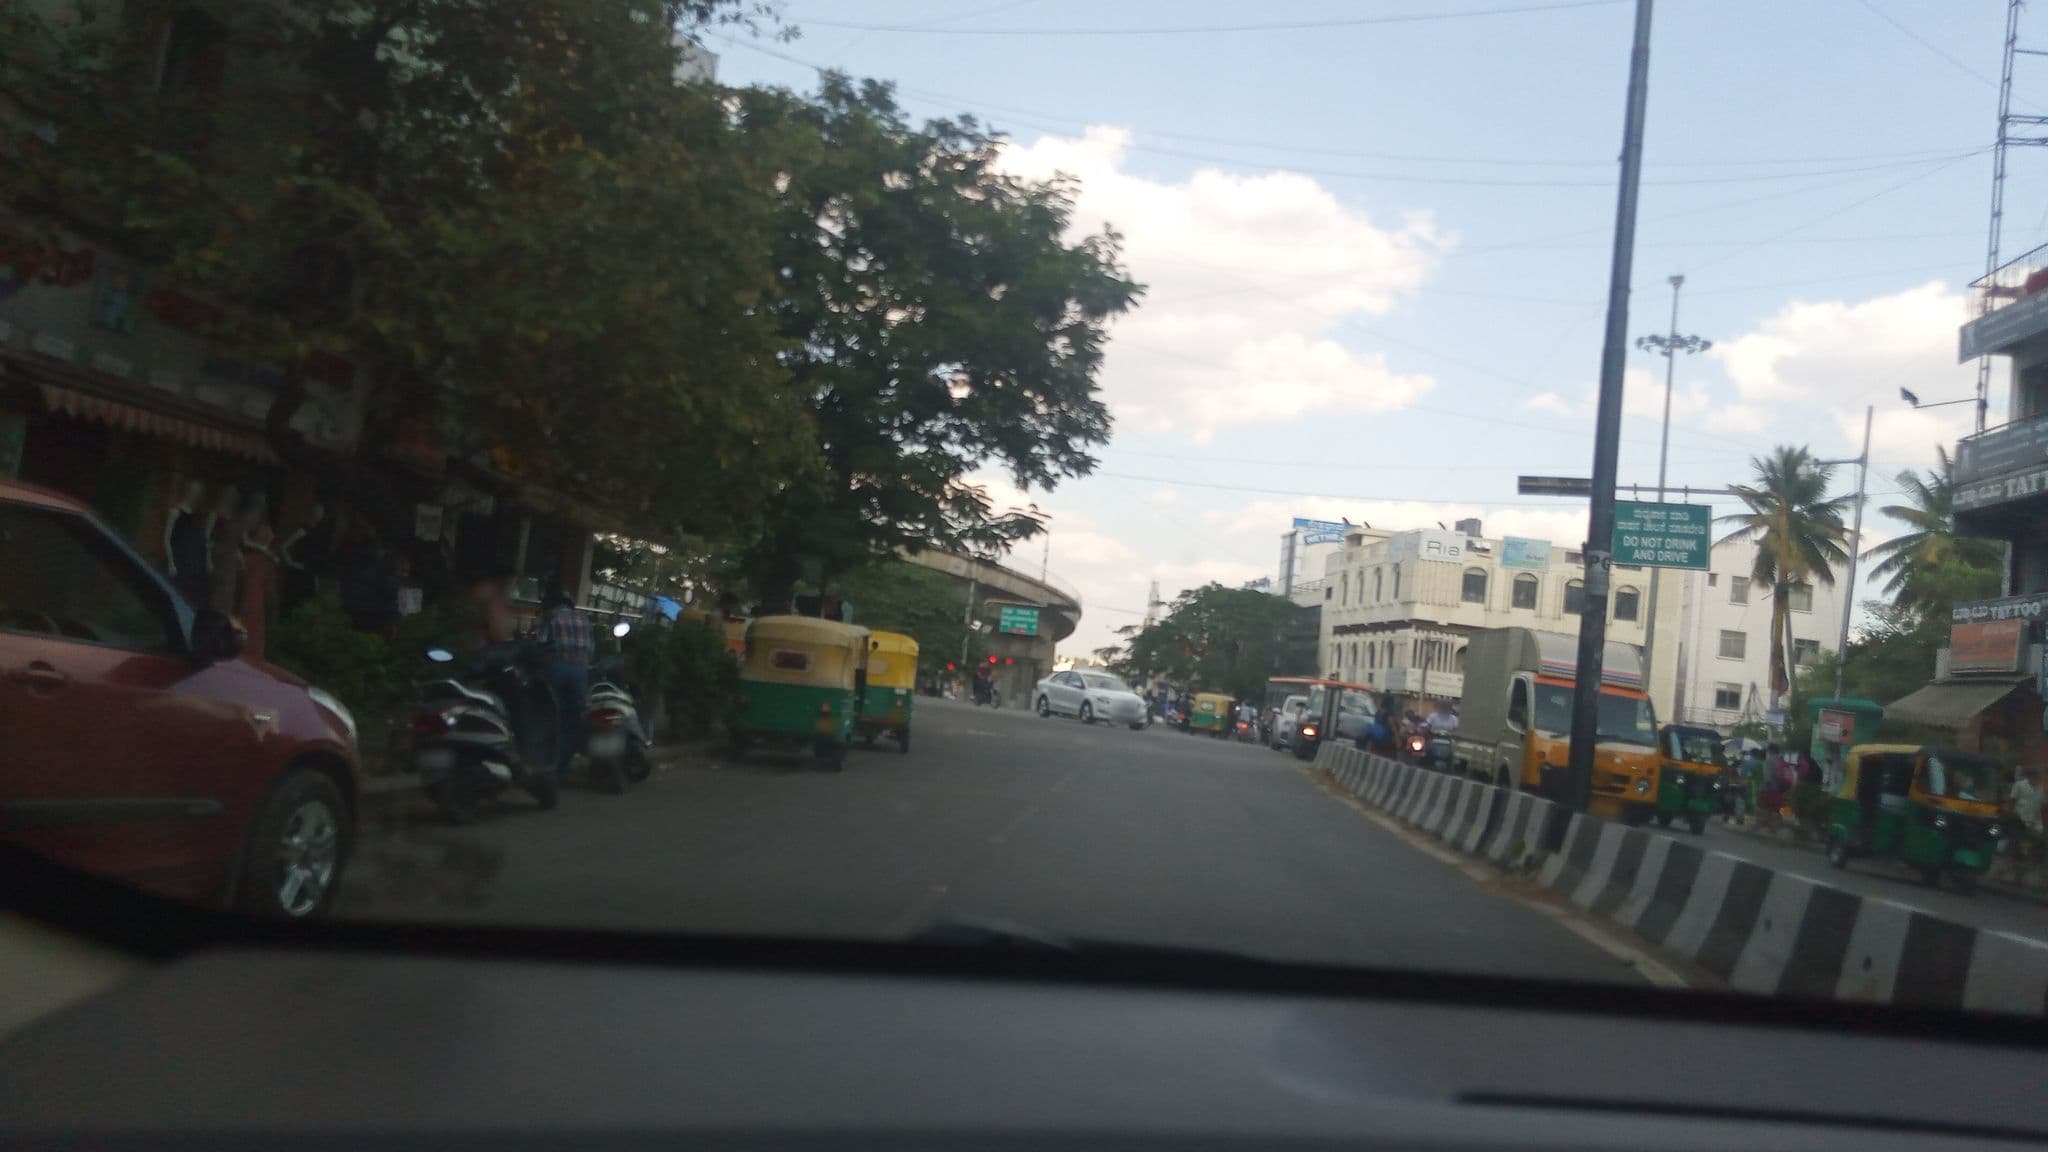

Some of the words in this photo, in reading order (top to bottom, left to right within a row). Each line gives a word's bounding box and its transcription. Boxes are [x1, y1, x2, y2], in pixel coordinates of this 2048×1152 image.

[1623, 535, 1638, 547] DO
[1640, 537, 1662, 548] NOT
[1664, 538, 1697, 551] DRINK
[1632, 549, 1655, 561] AND
[1657, 550, 1689, 563] DRIVE
[1989, 601, 2041, 620] TATTOO
